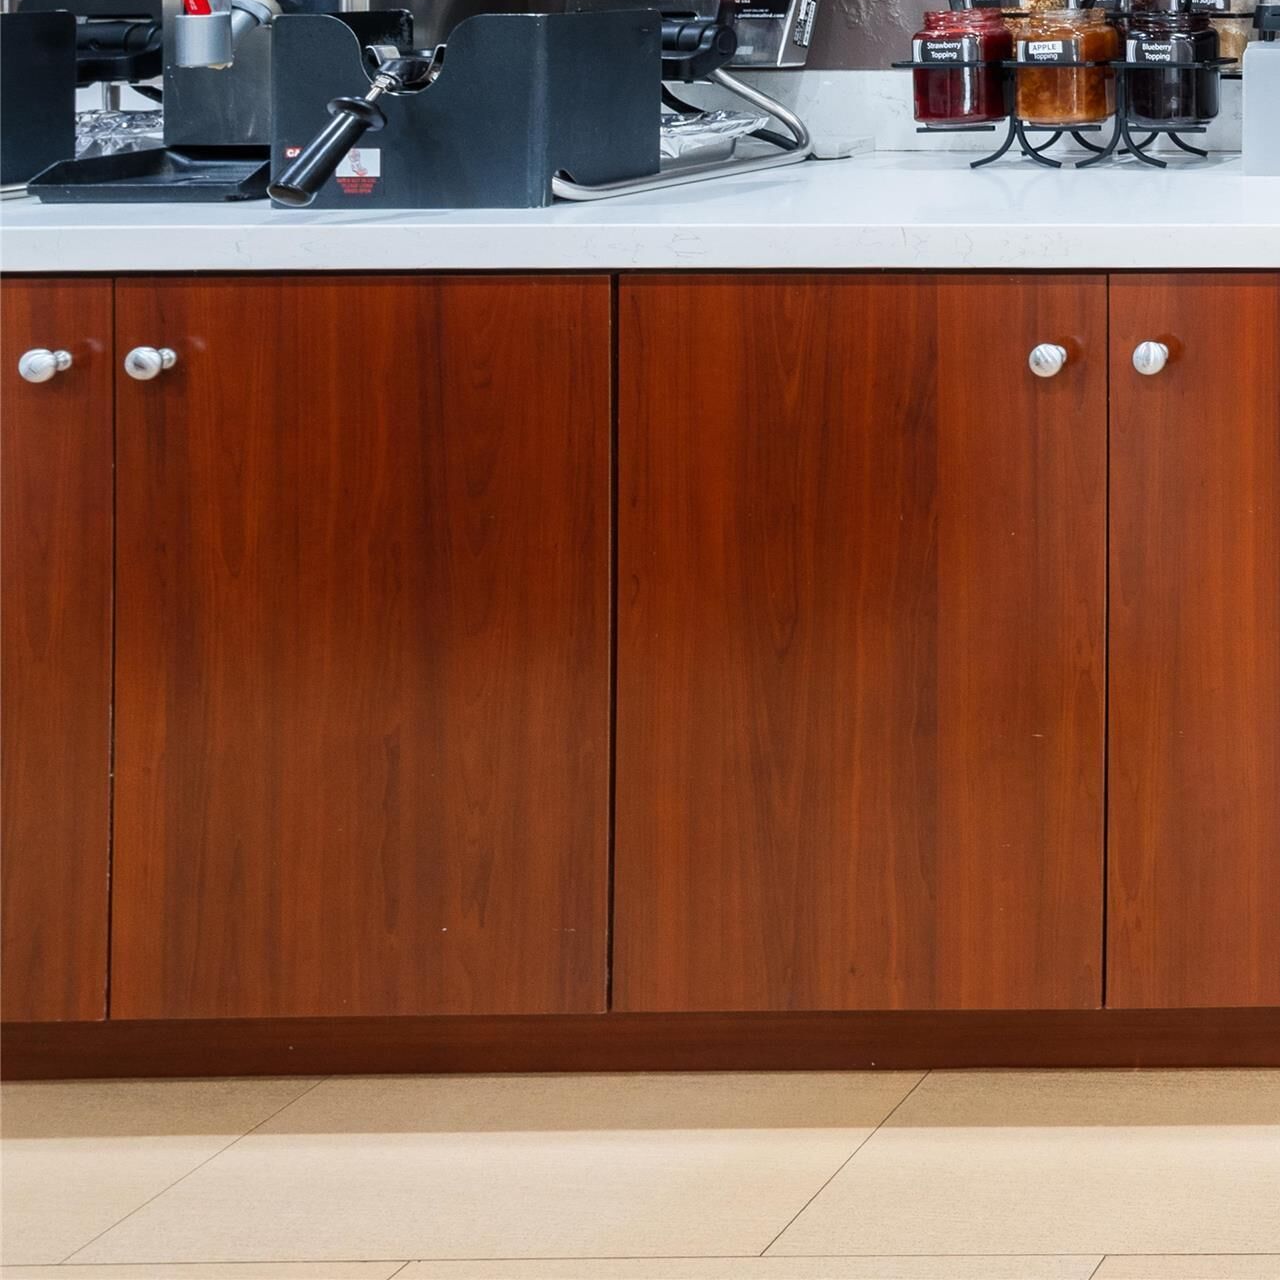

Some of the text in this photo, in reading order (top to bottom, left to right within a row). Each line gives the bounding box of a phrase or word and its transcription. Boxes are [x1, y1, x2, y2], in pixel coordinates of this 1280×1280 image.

[927, 41, 961, 50] Strawberry
[1032, 43, 1057, 51] APPLE
[1142, 43, 1172, 52] Blueberry
[931, 51, 957, 60] Topping
[1145, 52, 1170, 61] Topping
